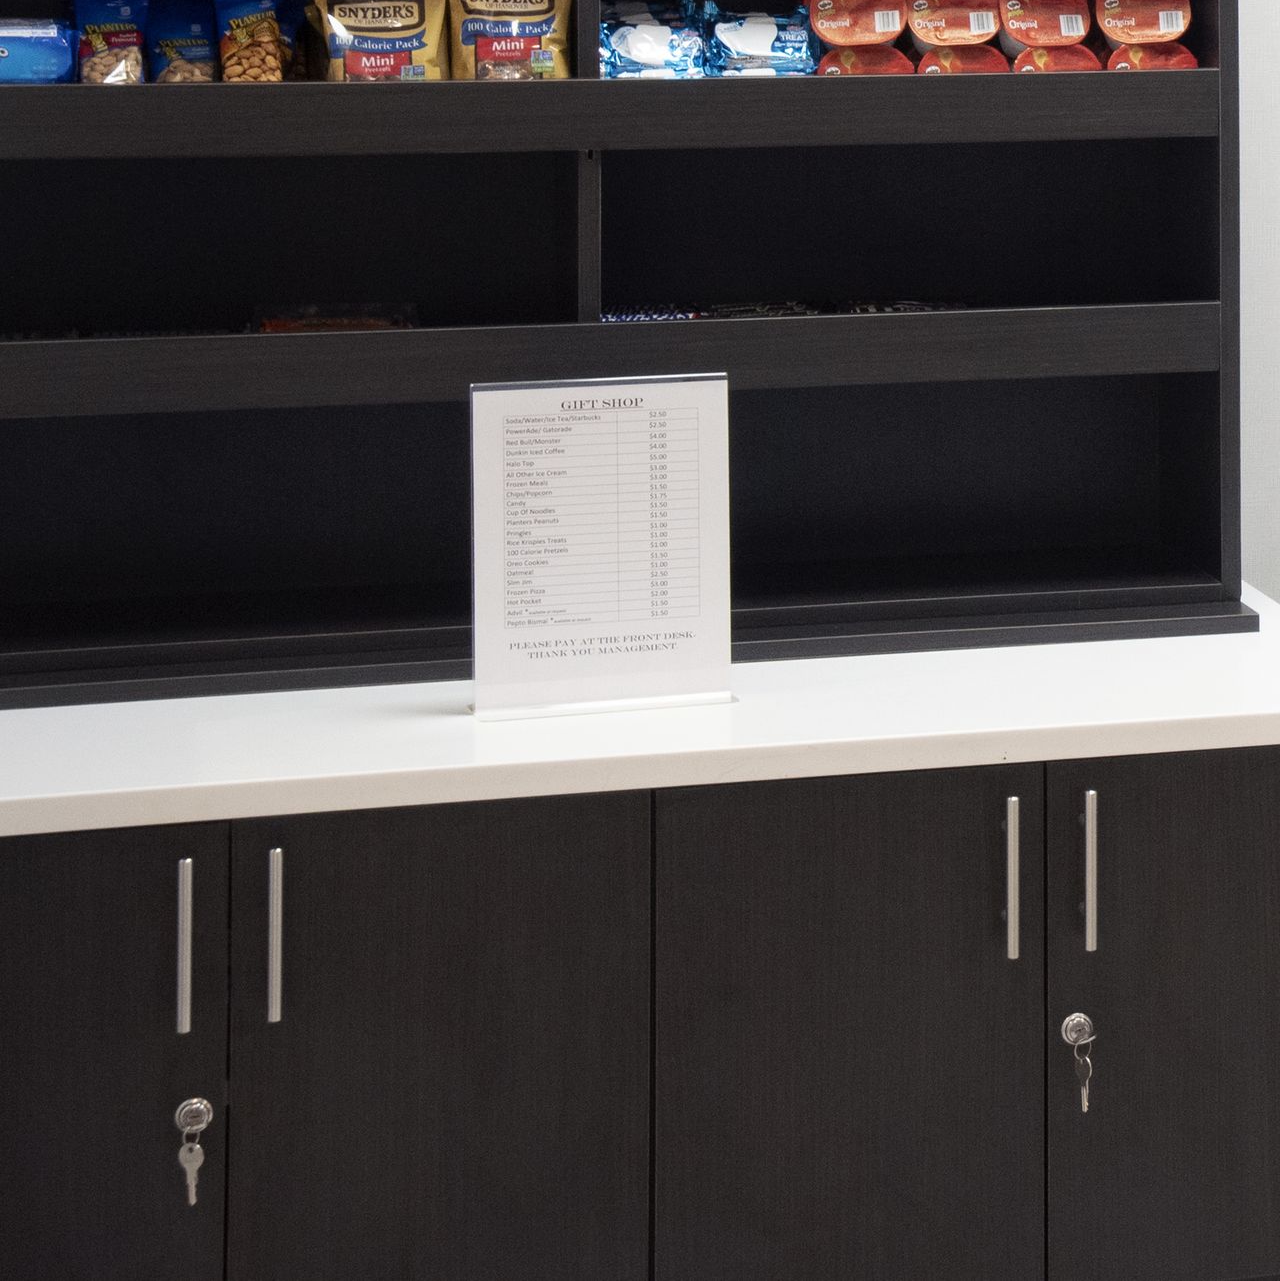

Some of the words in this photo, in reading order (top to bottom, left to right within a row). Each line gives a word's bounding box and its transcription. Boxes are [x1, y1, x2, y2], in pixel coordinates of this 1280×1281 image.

[338, 4, 415, 19] SNYDER'S
[354, 38, 392, 49] Calorie
[395, 39, 420, 49] Pack
[491, 40, 524, 51] Mini
[361, 54, 395, 67] Mini
[561, 399, 598, 410] GIFT
[602, 398, 643, 408] SHOP
[505, 449, 528, 457] Dunkin
[544, 447, 565, 455] Coffee
[522, 460, 534, 468] Top
[529, 479, 549, 487] Meals
[506, 500, 526, 508] Candy
[506, 509, 519, 517] Cup
[506, 530, 532, 538] Pringles
[521, 538, 546, 547] Krispies
[520, 548, 542, 556] Calorie
[506, 569, 534, 577] Oatmeal
[509, 640, 551, 650] PLEASE
[555, 638, 576, 647] PAY
[580, 637, 596, 646] AT
[600, 636, 620, 644] THE
[623, 633, 661, 643] FRONT
[664, 631, 696, 640] DESK.
[527, 650, 568, 659] THANK
[570, 648, 595, 656] YOU
[600, 642, 677, 655] MANAGEMENT
